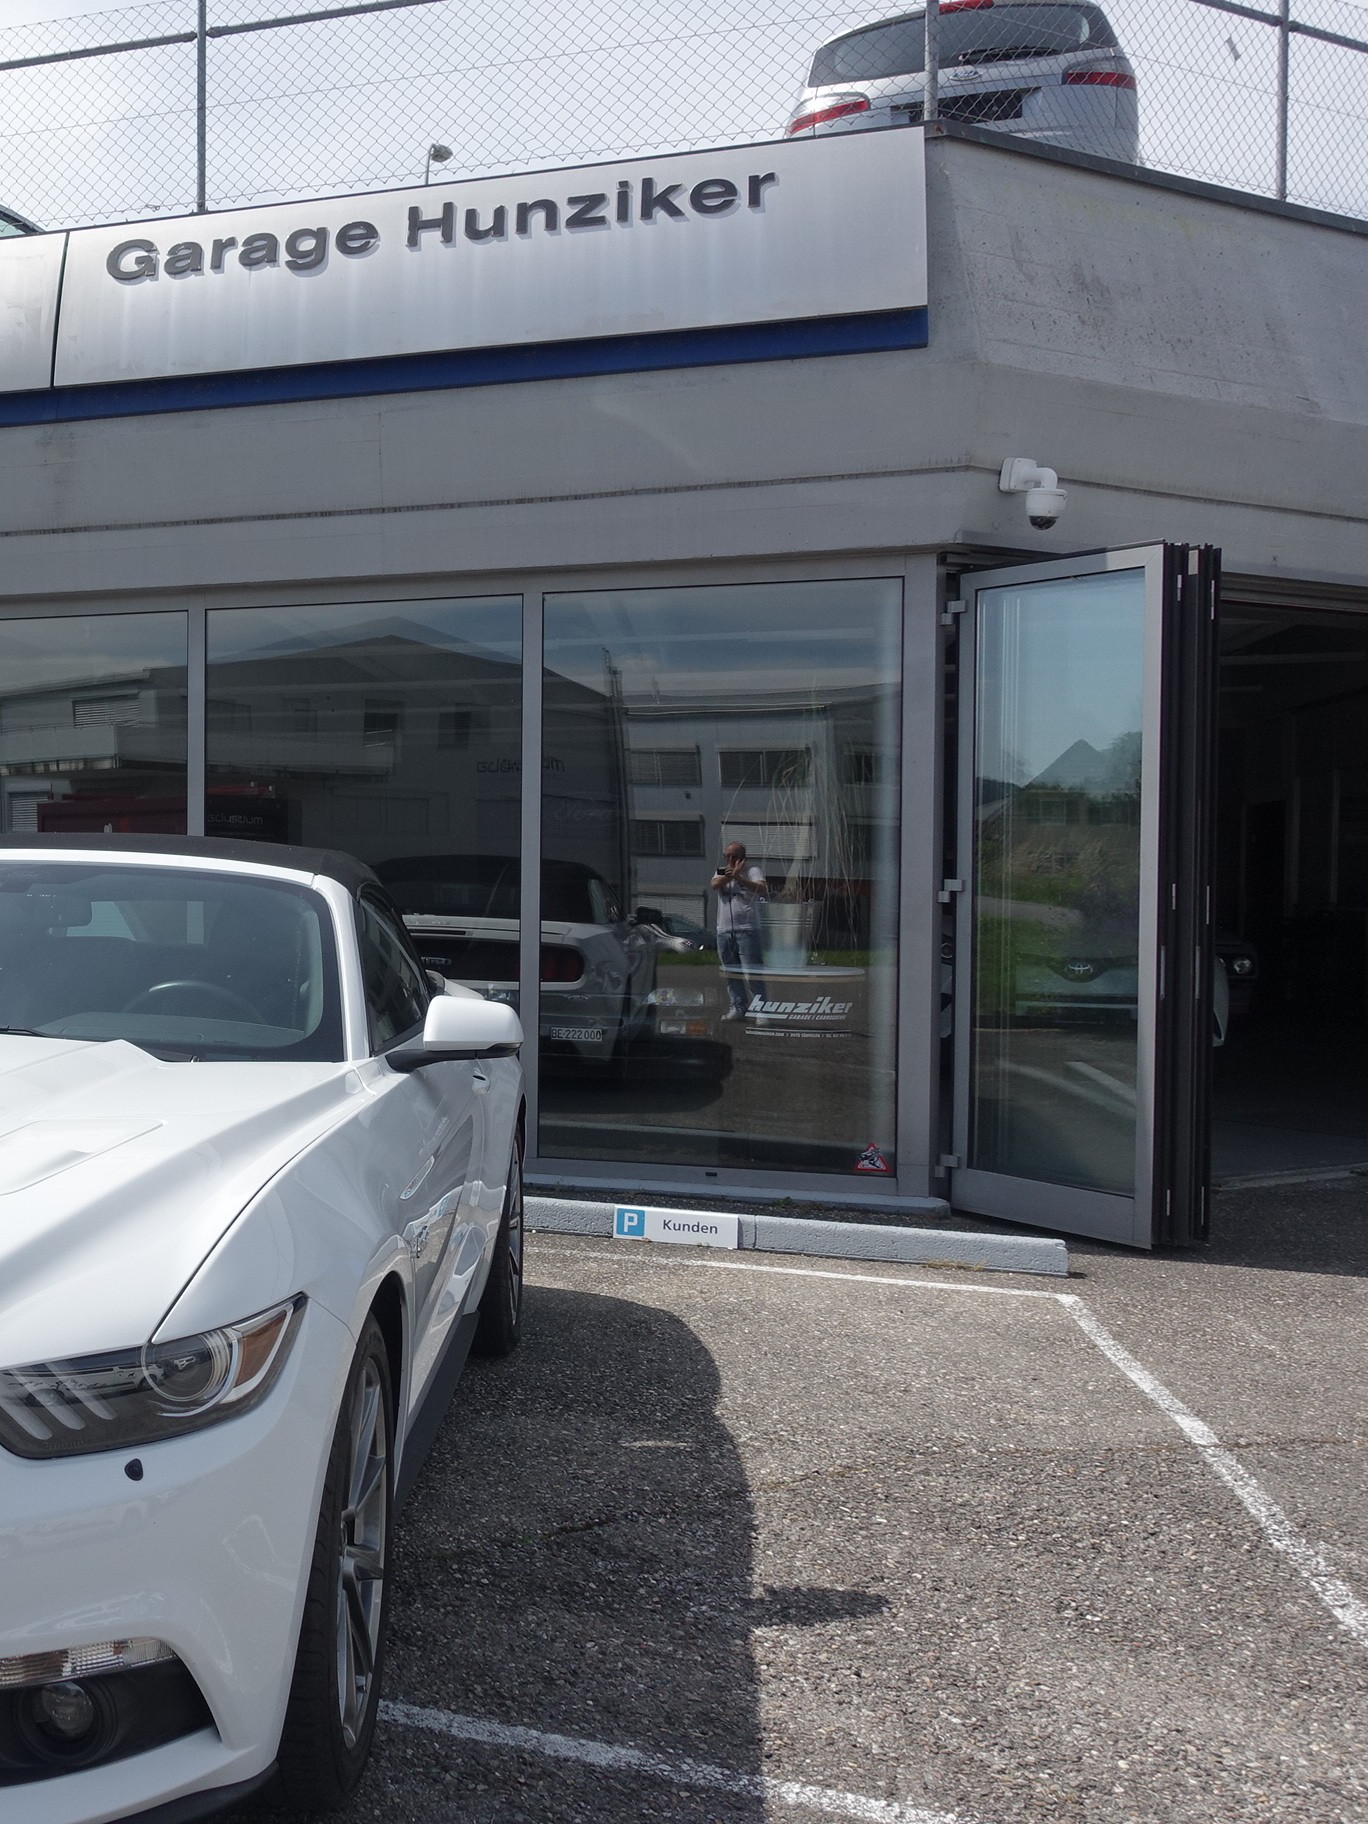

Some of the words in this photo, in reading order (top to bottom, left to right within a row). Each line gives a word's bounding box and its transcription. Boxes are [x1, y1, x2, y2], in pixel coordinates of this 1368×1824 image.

[106, 221, 380, 280] Garage
[406, 172, 776, 248] Hunziker
[747, 994, 853, 1014] hunziker
[623, 1212, 639, 1233] P
[662, 1219, 718, 1235] Kunden
